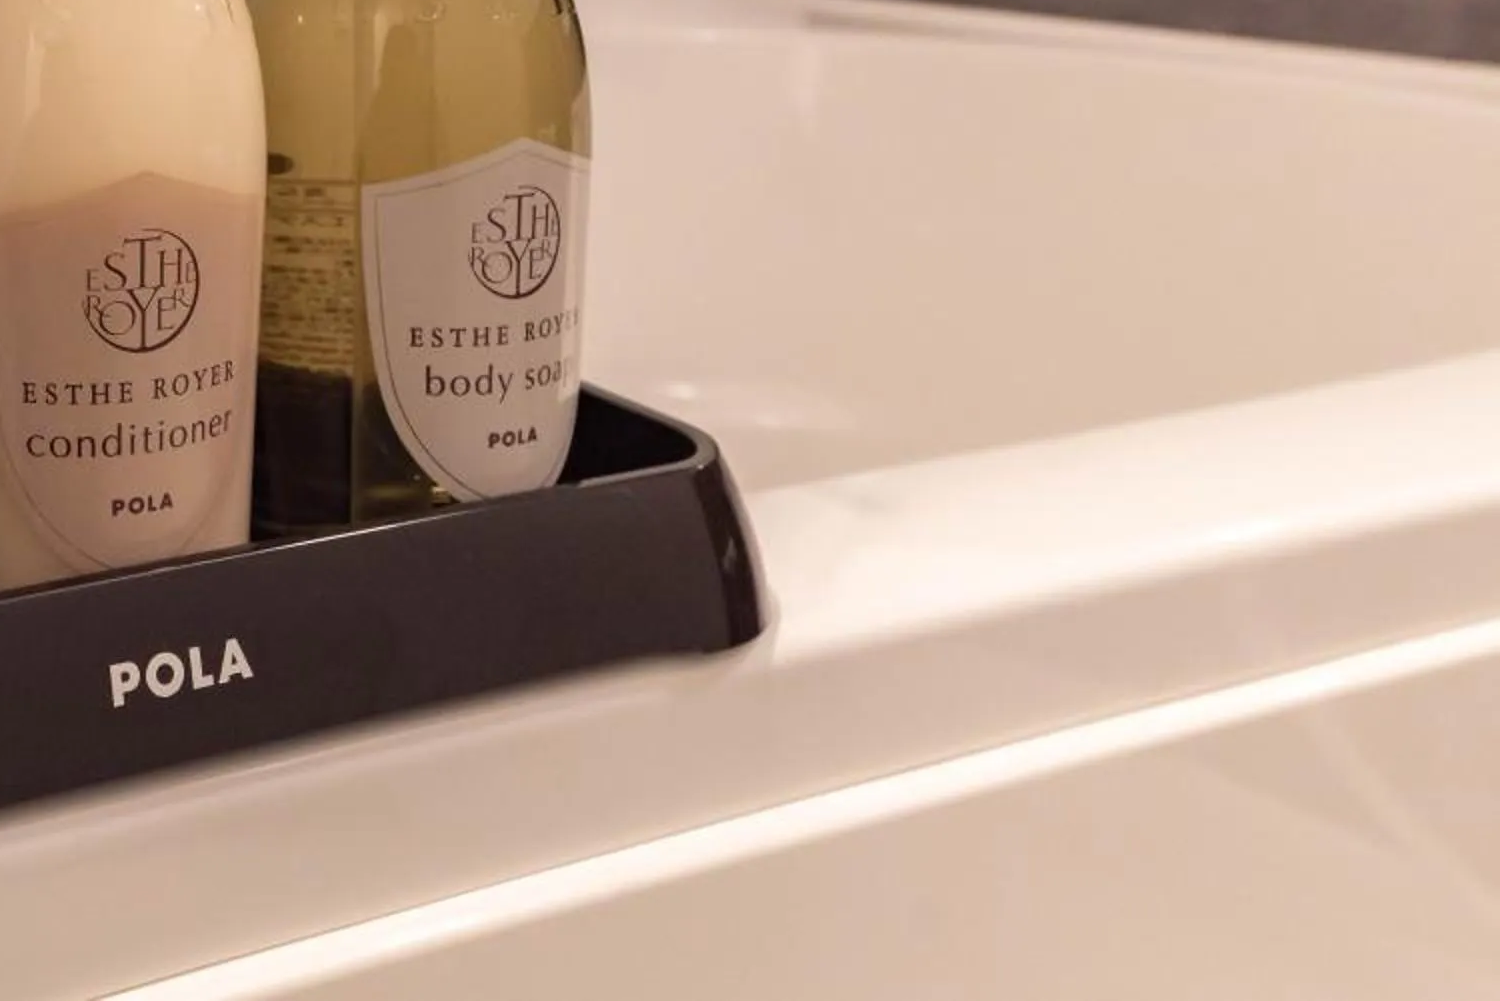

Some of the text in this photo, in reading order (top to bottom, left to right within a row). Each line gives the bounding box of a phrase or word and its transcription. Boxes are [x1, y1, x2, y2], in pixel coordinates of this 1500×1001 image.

[409, 324, 510, 349] ESTHE
[21, 359, 236, 406] ESTHE ROYER
[424, 362, 514, 405] body
[25, 409, 233, 459] conditioner
[488, 426, 538, 450] POLA
[110, 491, 174, 517] POLA
[108, 637, 255, 708] POLA
